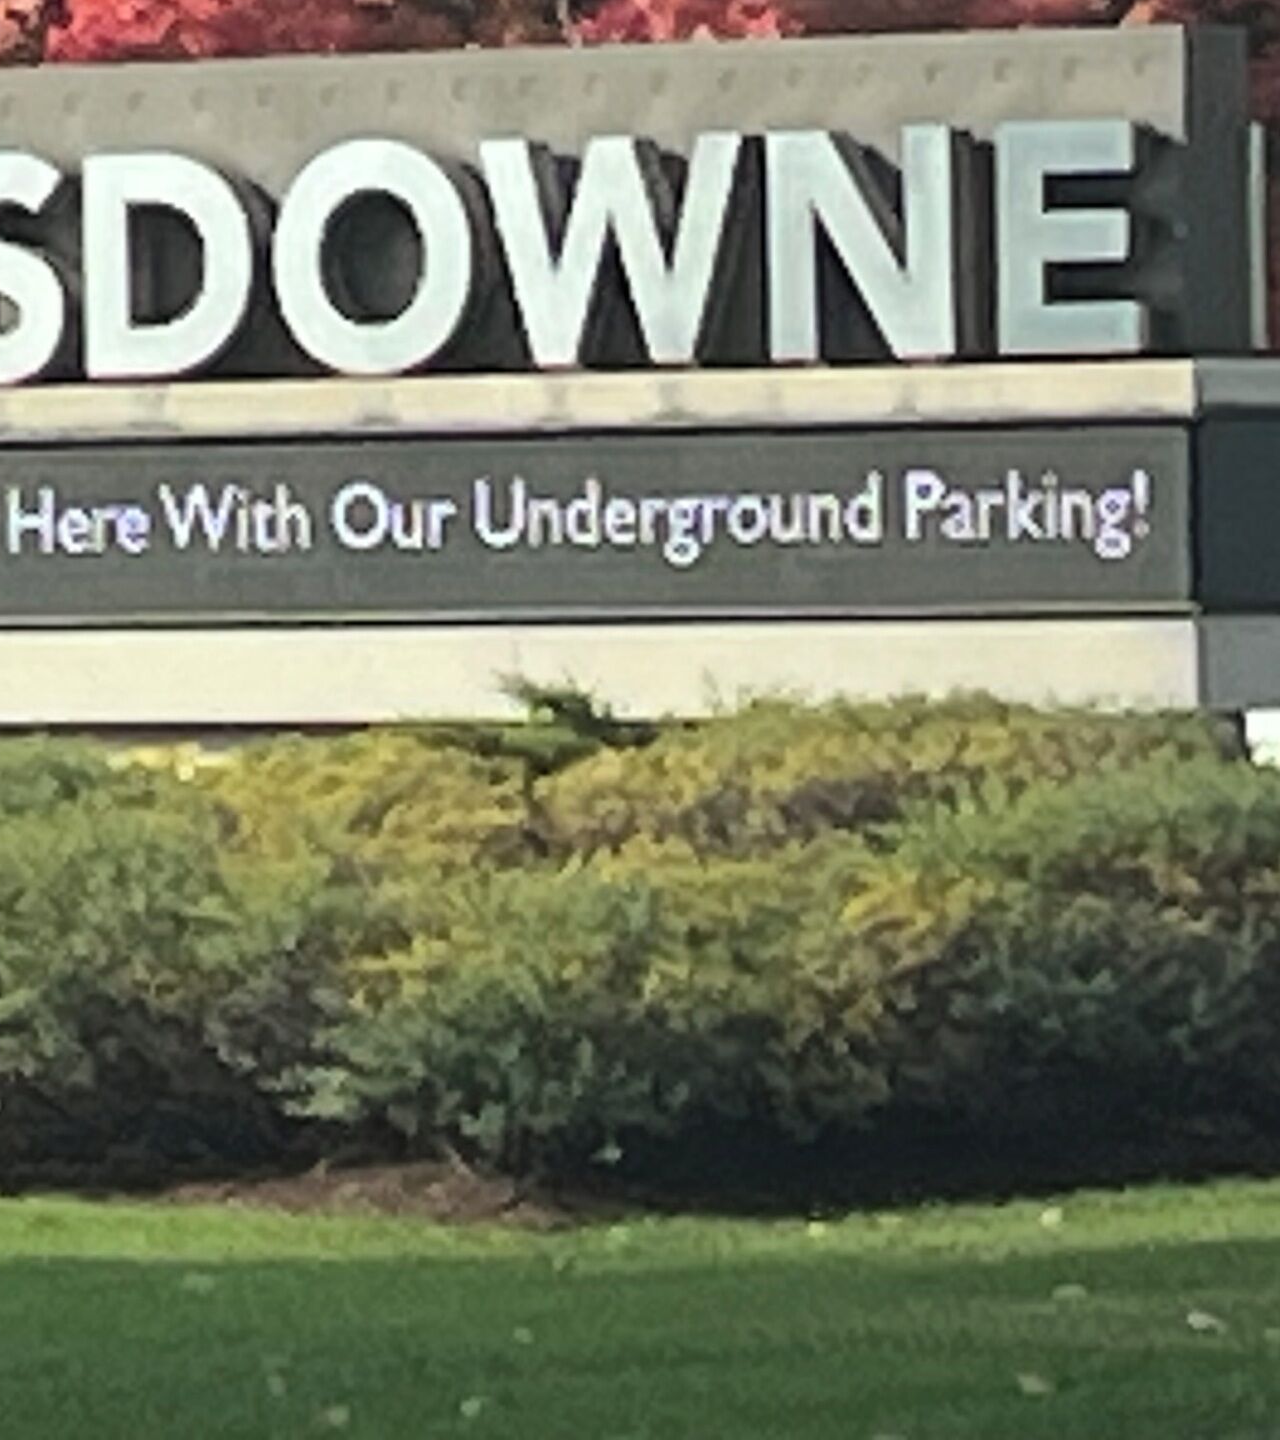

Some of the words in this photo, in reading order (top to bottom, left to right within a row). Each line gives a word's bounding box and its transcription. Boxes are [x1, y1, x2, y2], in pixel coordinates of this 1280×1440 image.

[6, 483, 150, 554] Here
[158, 482, 312, 552] With
[330, 480, 457, 550] Our
[474, 470, 883, 568] Underground
[904, 469, 1150, 559] Parking!
